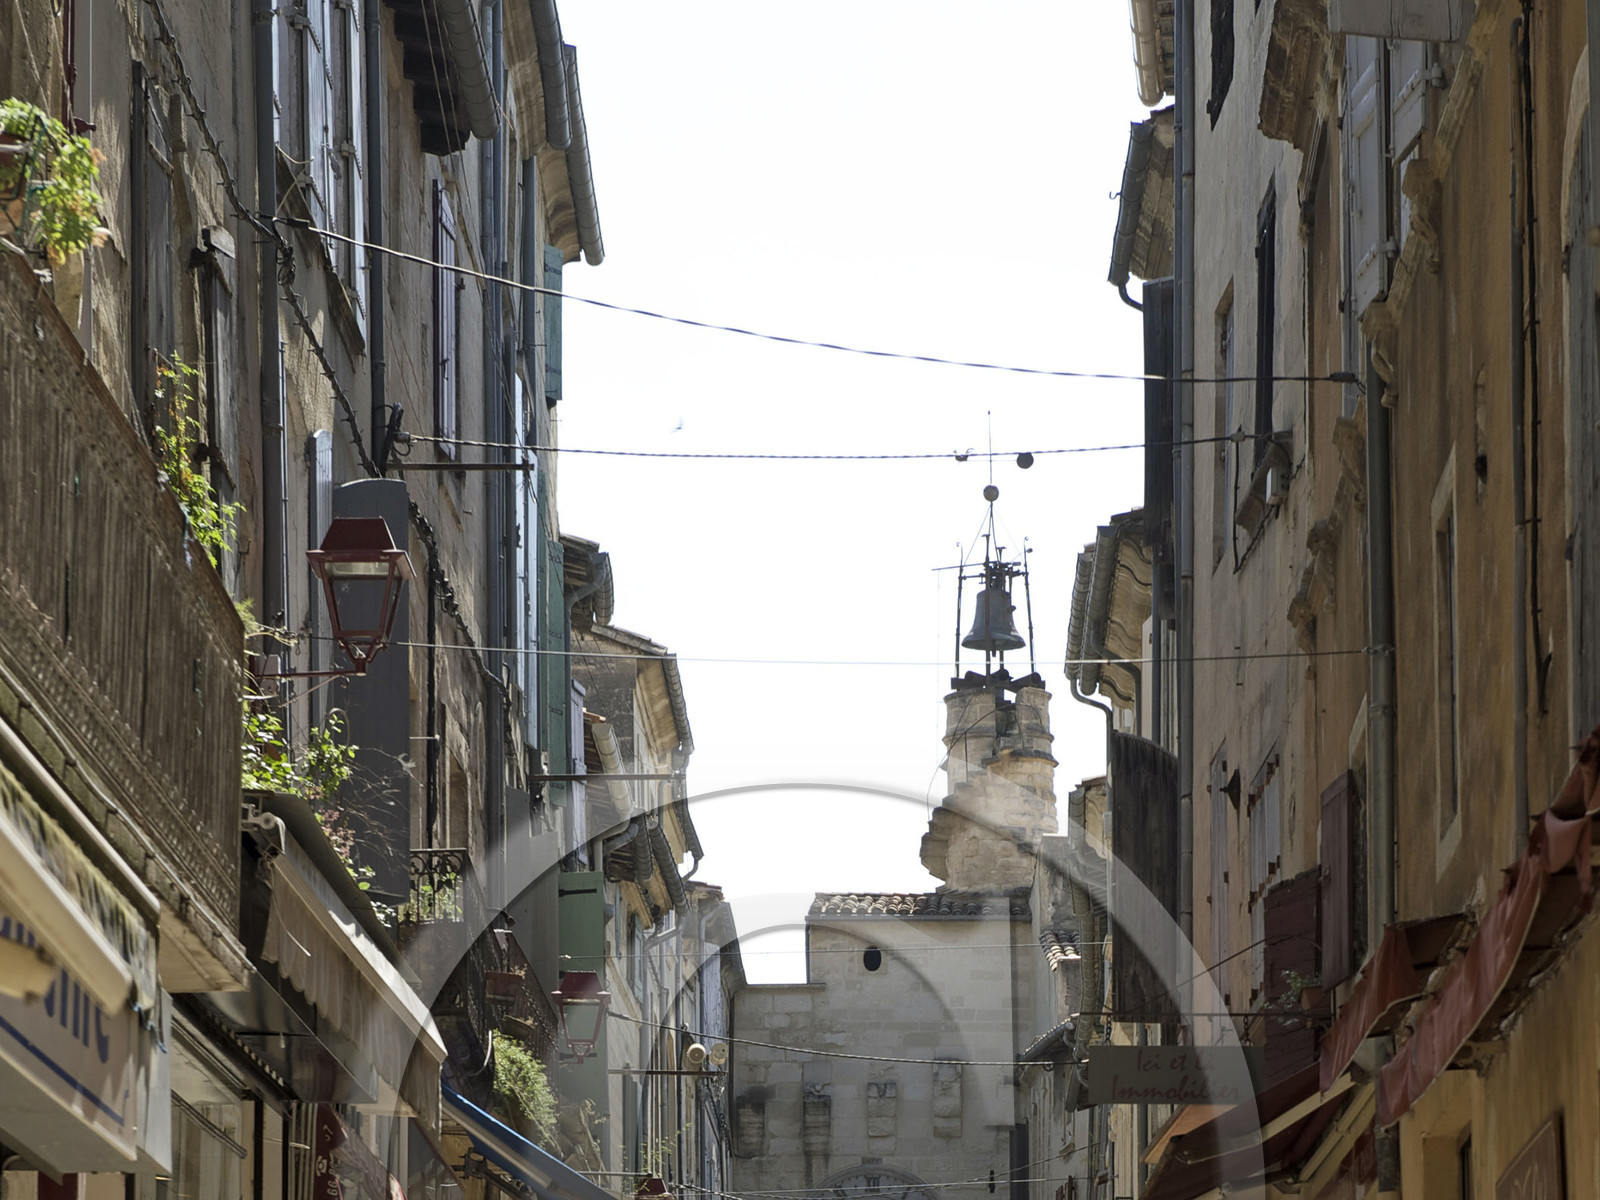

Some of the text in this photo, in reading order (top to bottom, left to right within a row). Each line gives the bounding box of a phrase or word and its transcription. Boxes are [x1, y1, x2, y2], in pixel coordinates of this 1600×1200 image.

[1136, 1048, 1162, 1072] Ici
[1169, 1052, 1188, 1071] et
[1112, 1074, 1241, 1101] Immobilier
